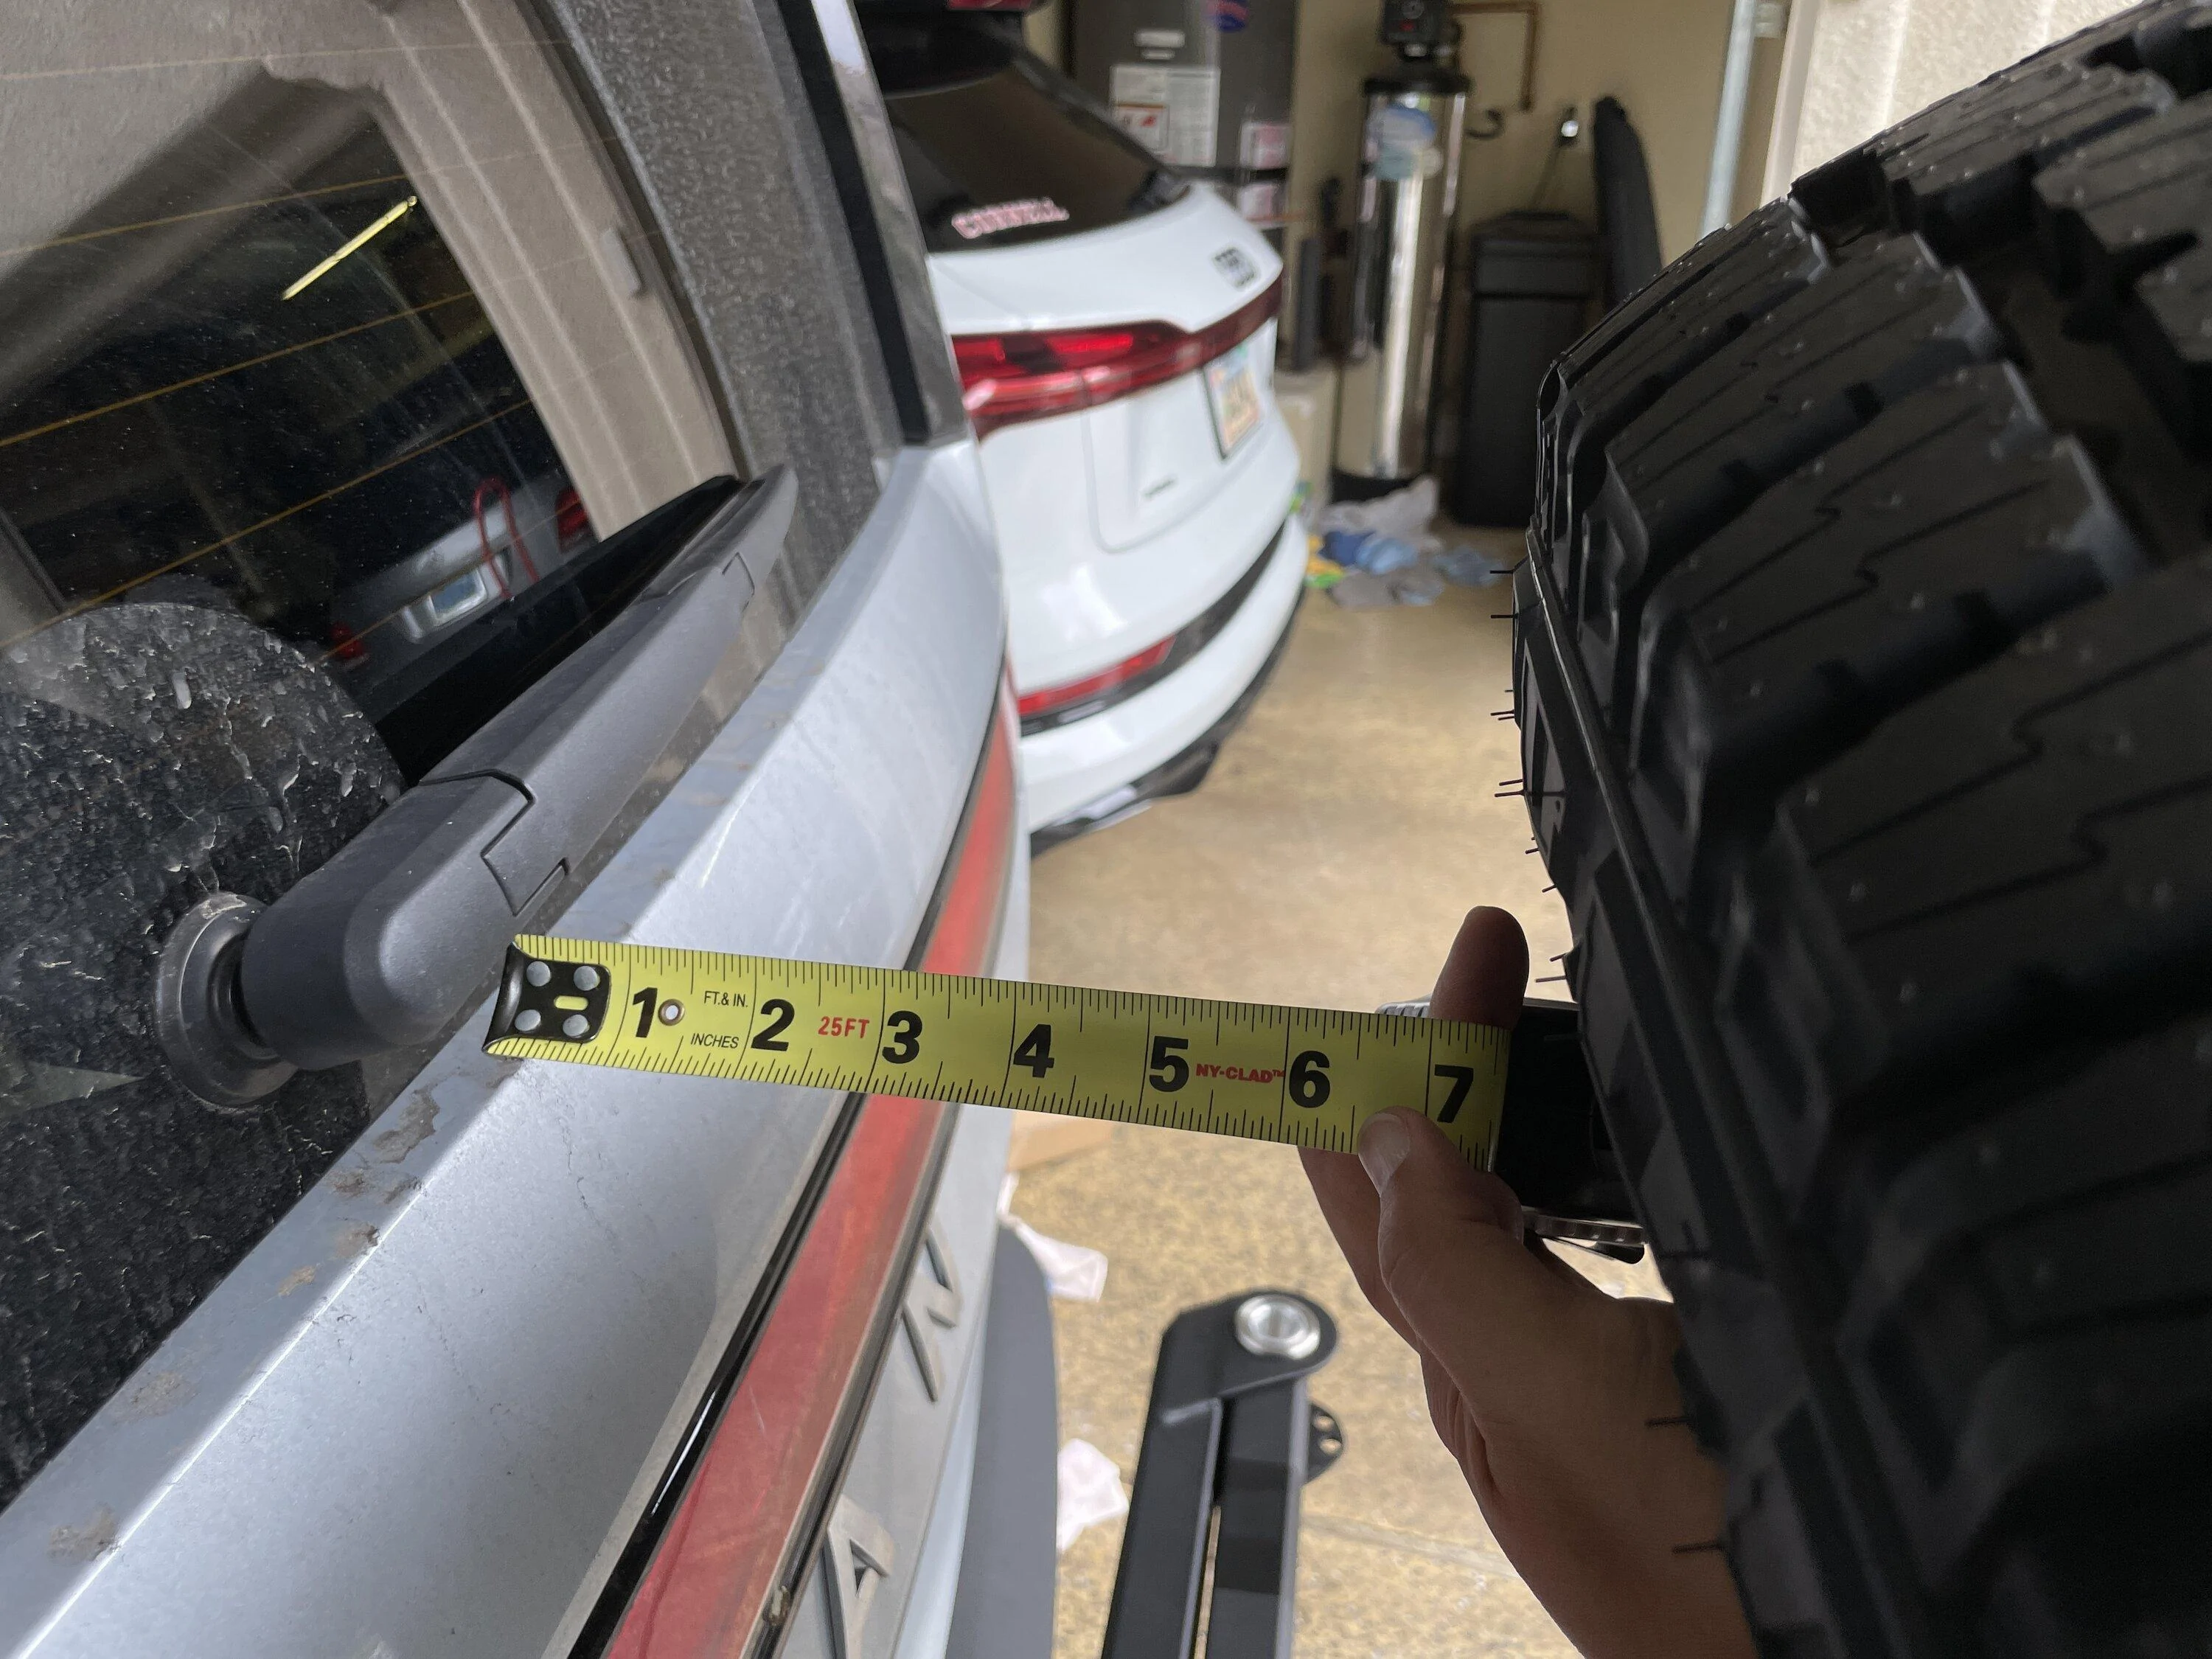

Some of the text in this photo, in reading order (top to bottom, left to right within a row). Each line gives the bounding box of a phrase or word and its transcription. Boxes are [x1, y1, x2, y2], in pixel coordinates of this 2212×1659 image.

[633, 987, 658, 1037] 1
[751, 998, 796, 1051] 2
[882, 1010, 923, 1064] 3
[690, 1033, 739, 1049] INCHES
[1013, 1023, 1055, 1079] 4
[1149, 1036, 1189, 1092] 5
[1288, 1050, 1331, 1108] 6
[1433, 1065, 1474, 1123] 7
